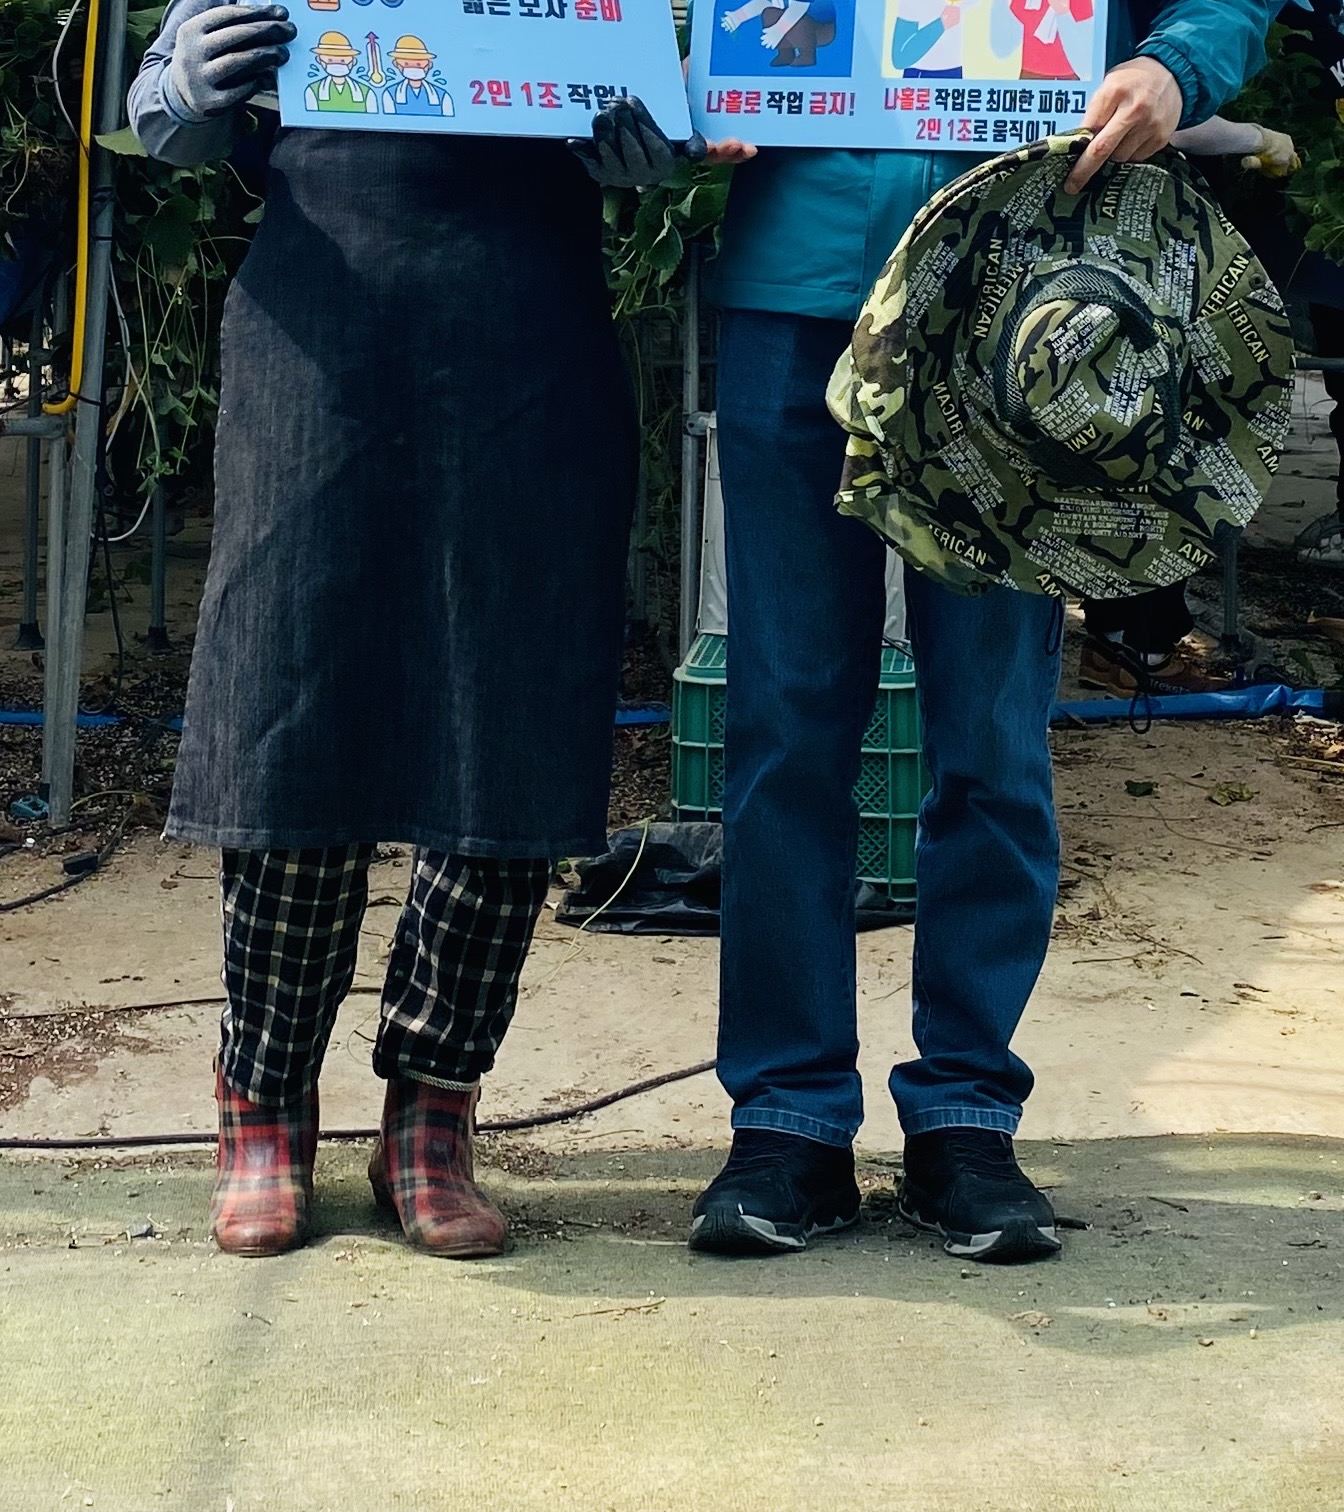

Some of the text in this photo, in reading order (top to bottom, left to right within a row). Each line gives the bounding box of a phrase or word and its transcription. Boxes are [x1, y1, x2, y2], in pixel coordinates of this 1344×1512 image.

[469, 79, 513, 107] 2인
[520, 82, 563, 109] 1조
[706, 89, 856, 117] 나홀로 작업 금지!
[884, 87, 1087, 114] 나홀로 작업은 최대한 피하고
[916, 118, 1057, 143] 2인 1조로 움직이기
